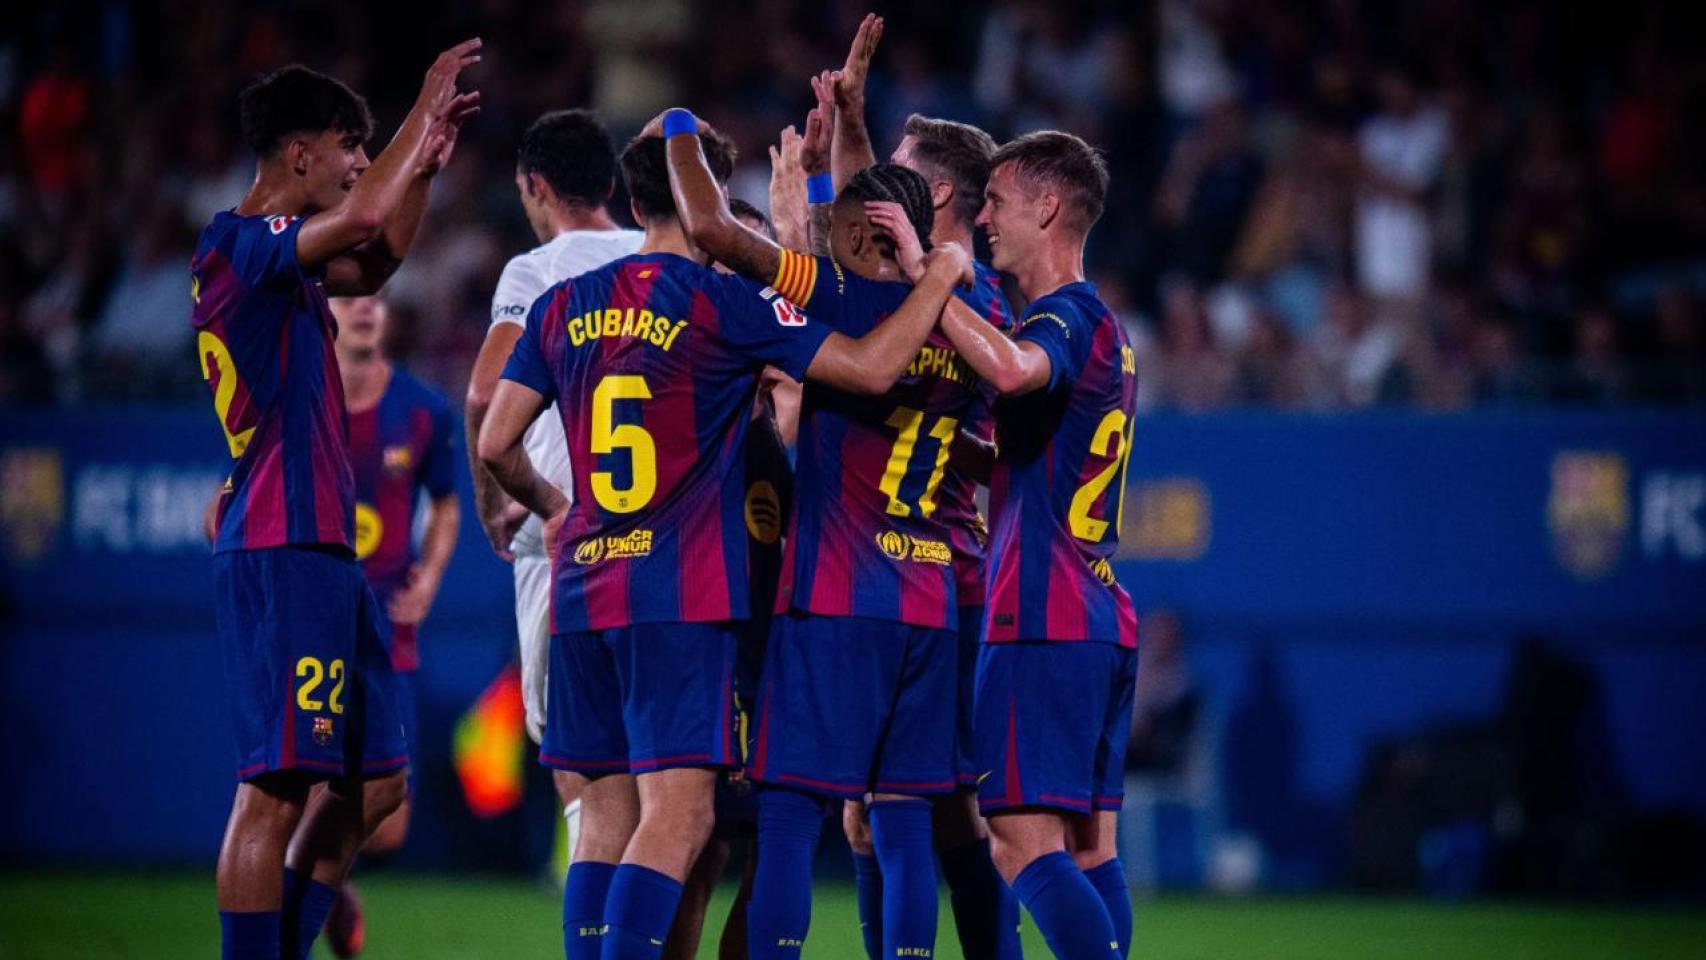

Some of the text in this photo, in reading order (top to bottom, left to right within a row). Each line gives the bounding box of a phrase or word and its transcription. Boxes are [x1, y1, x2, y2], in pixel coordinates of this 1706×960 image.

[590, 374, 657, 514] 5
[879, 404, 959, 518] 11
[296, 656, 344, 714] 22
